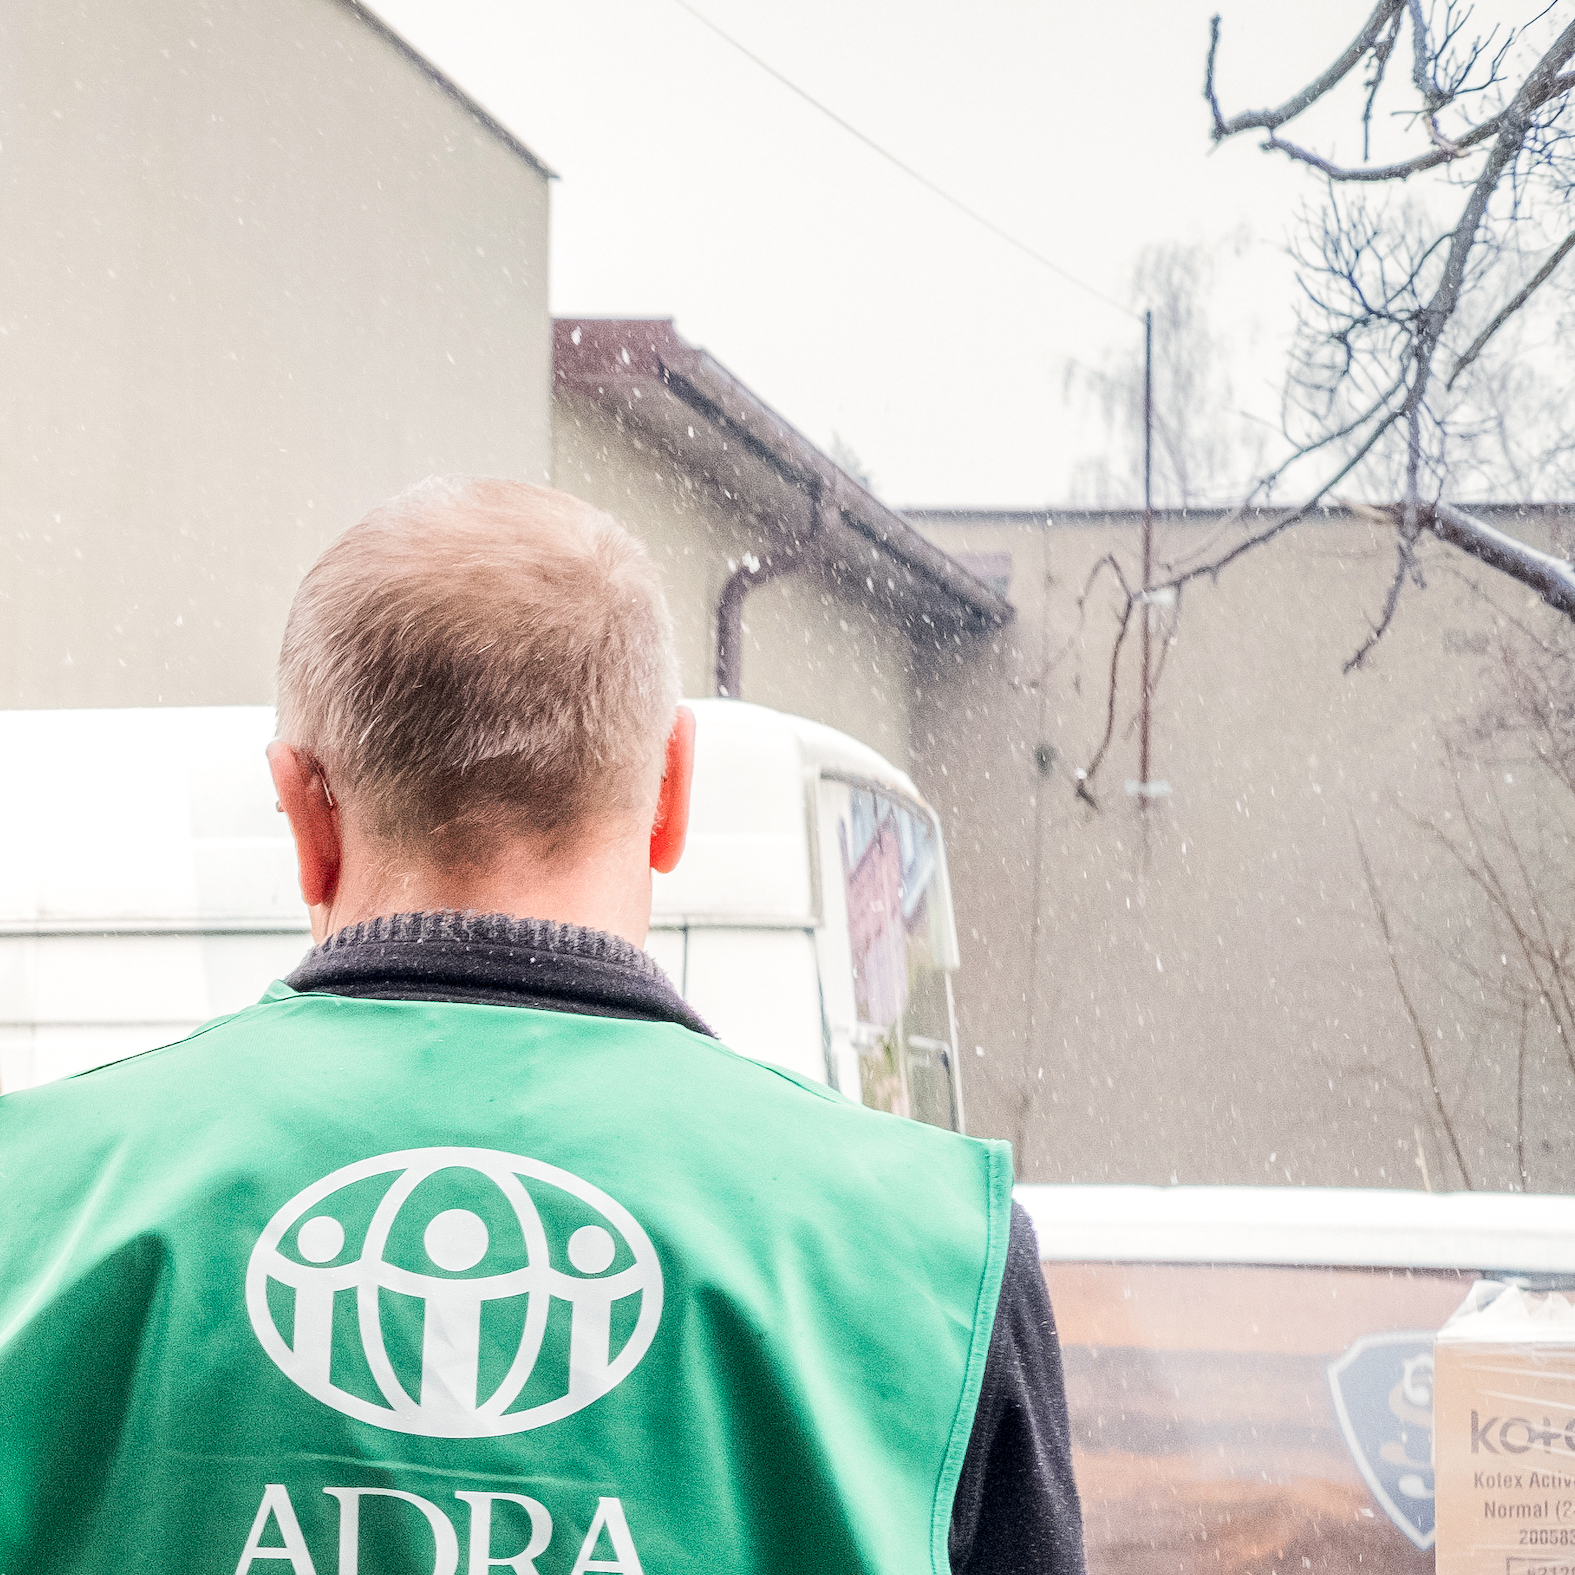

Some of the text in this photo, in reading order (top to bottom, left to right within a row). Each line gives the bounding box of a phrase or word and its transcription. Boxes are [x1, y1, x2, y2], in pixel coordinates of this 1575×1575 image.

[1474, 1470, 1575, 1489] Kotex Activ
[1484, 1500, 1549, 1520] Normal
